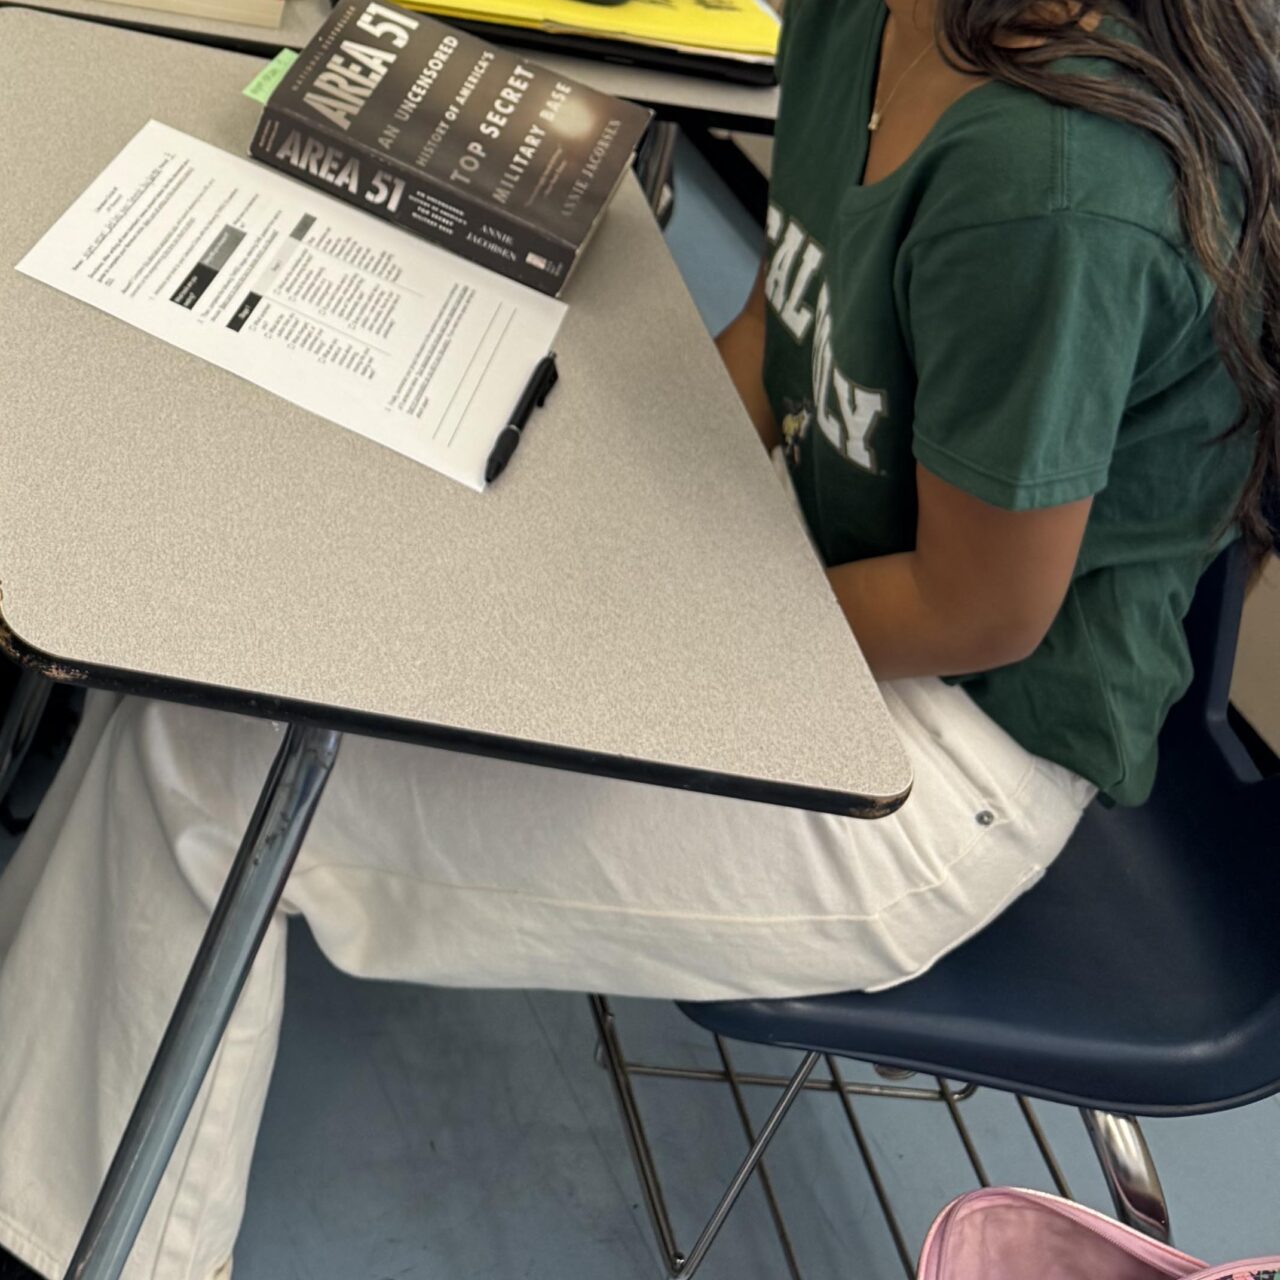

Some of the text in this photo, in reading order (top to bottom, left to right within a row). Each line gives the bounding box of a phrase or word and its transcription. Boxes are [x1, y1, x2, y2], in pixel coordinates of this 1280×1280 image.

[303, 2, 420, 131] AREA 51
[377, 35, 459, 150] AN UNCENSORED
[415, 50, 496, 167] HISTORY OF AMERICA'S
[450, 65, 535, 184] TOP SECRET
[276, 129, 406, 213] AREA 51
[492, 81, 572, 205] MILITARY BASE
[466, 231, 517, 262] JACOBSEN
[480, 224, 514, 244] ANNIE
